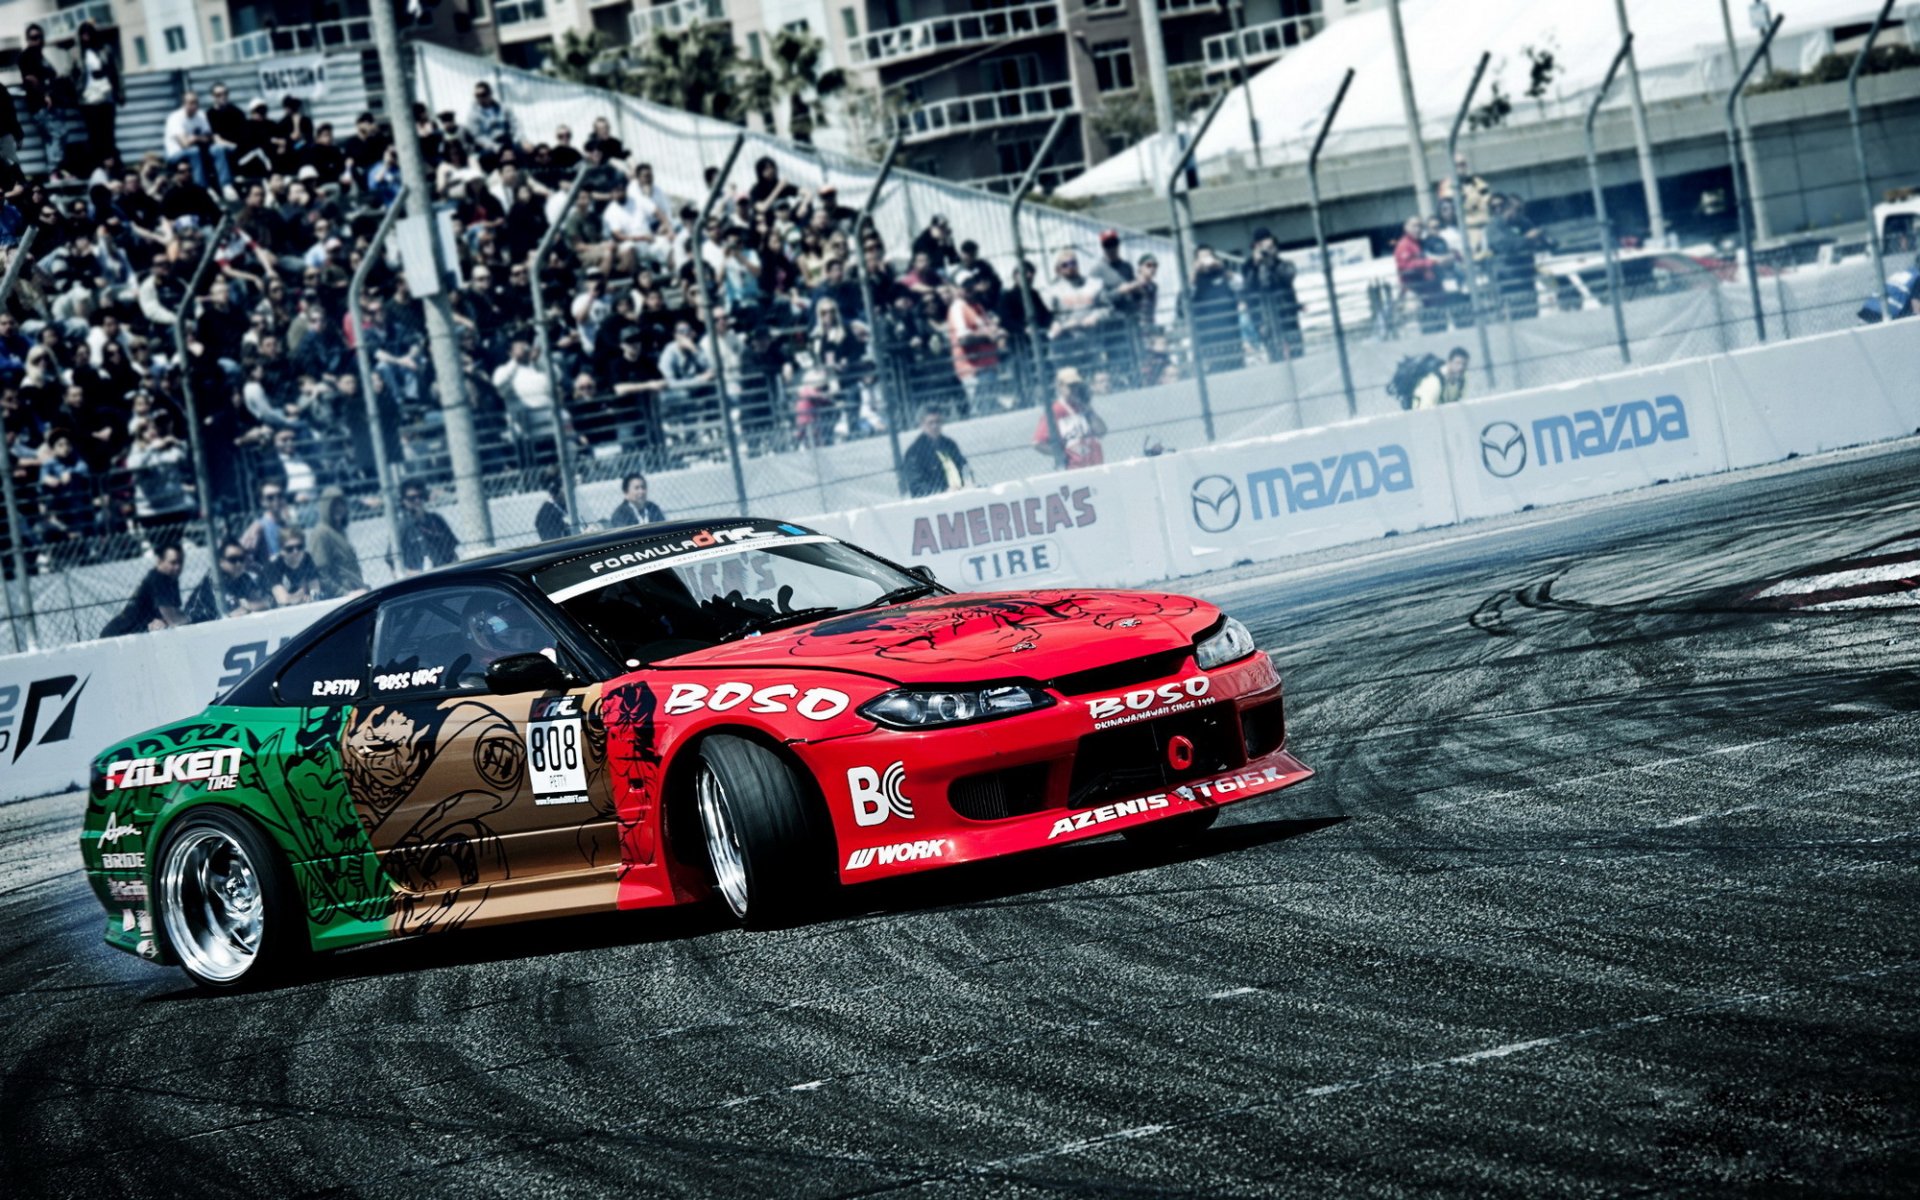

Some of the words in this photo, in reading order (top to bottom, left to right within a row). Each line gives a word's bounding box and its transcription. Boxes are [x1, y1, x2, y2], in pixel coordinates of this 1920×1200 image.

[912, 485, 1097, 556] AMERICA'S
[968, 544, 1050, 581] TIRE
[664, 681, 850, 721] BOSO
[1085, 676, 1210, 719] BOSO
[1171, 700, 1195, 713] SINCE
[104, 747, 243, 791] FALKEN
[531, 725, 577, 772] 808
[207, 774, 239, 792] TIRE
[846, 760, 916, 828] BC
[1047, 793, 1170, 840] AZENIS
[101, 852, 146, 868] BRIDE
[877, 838, 947, 865] WORK
